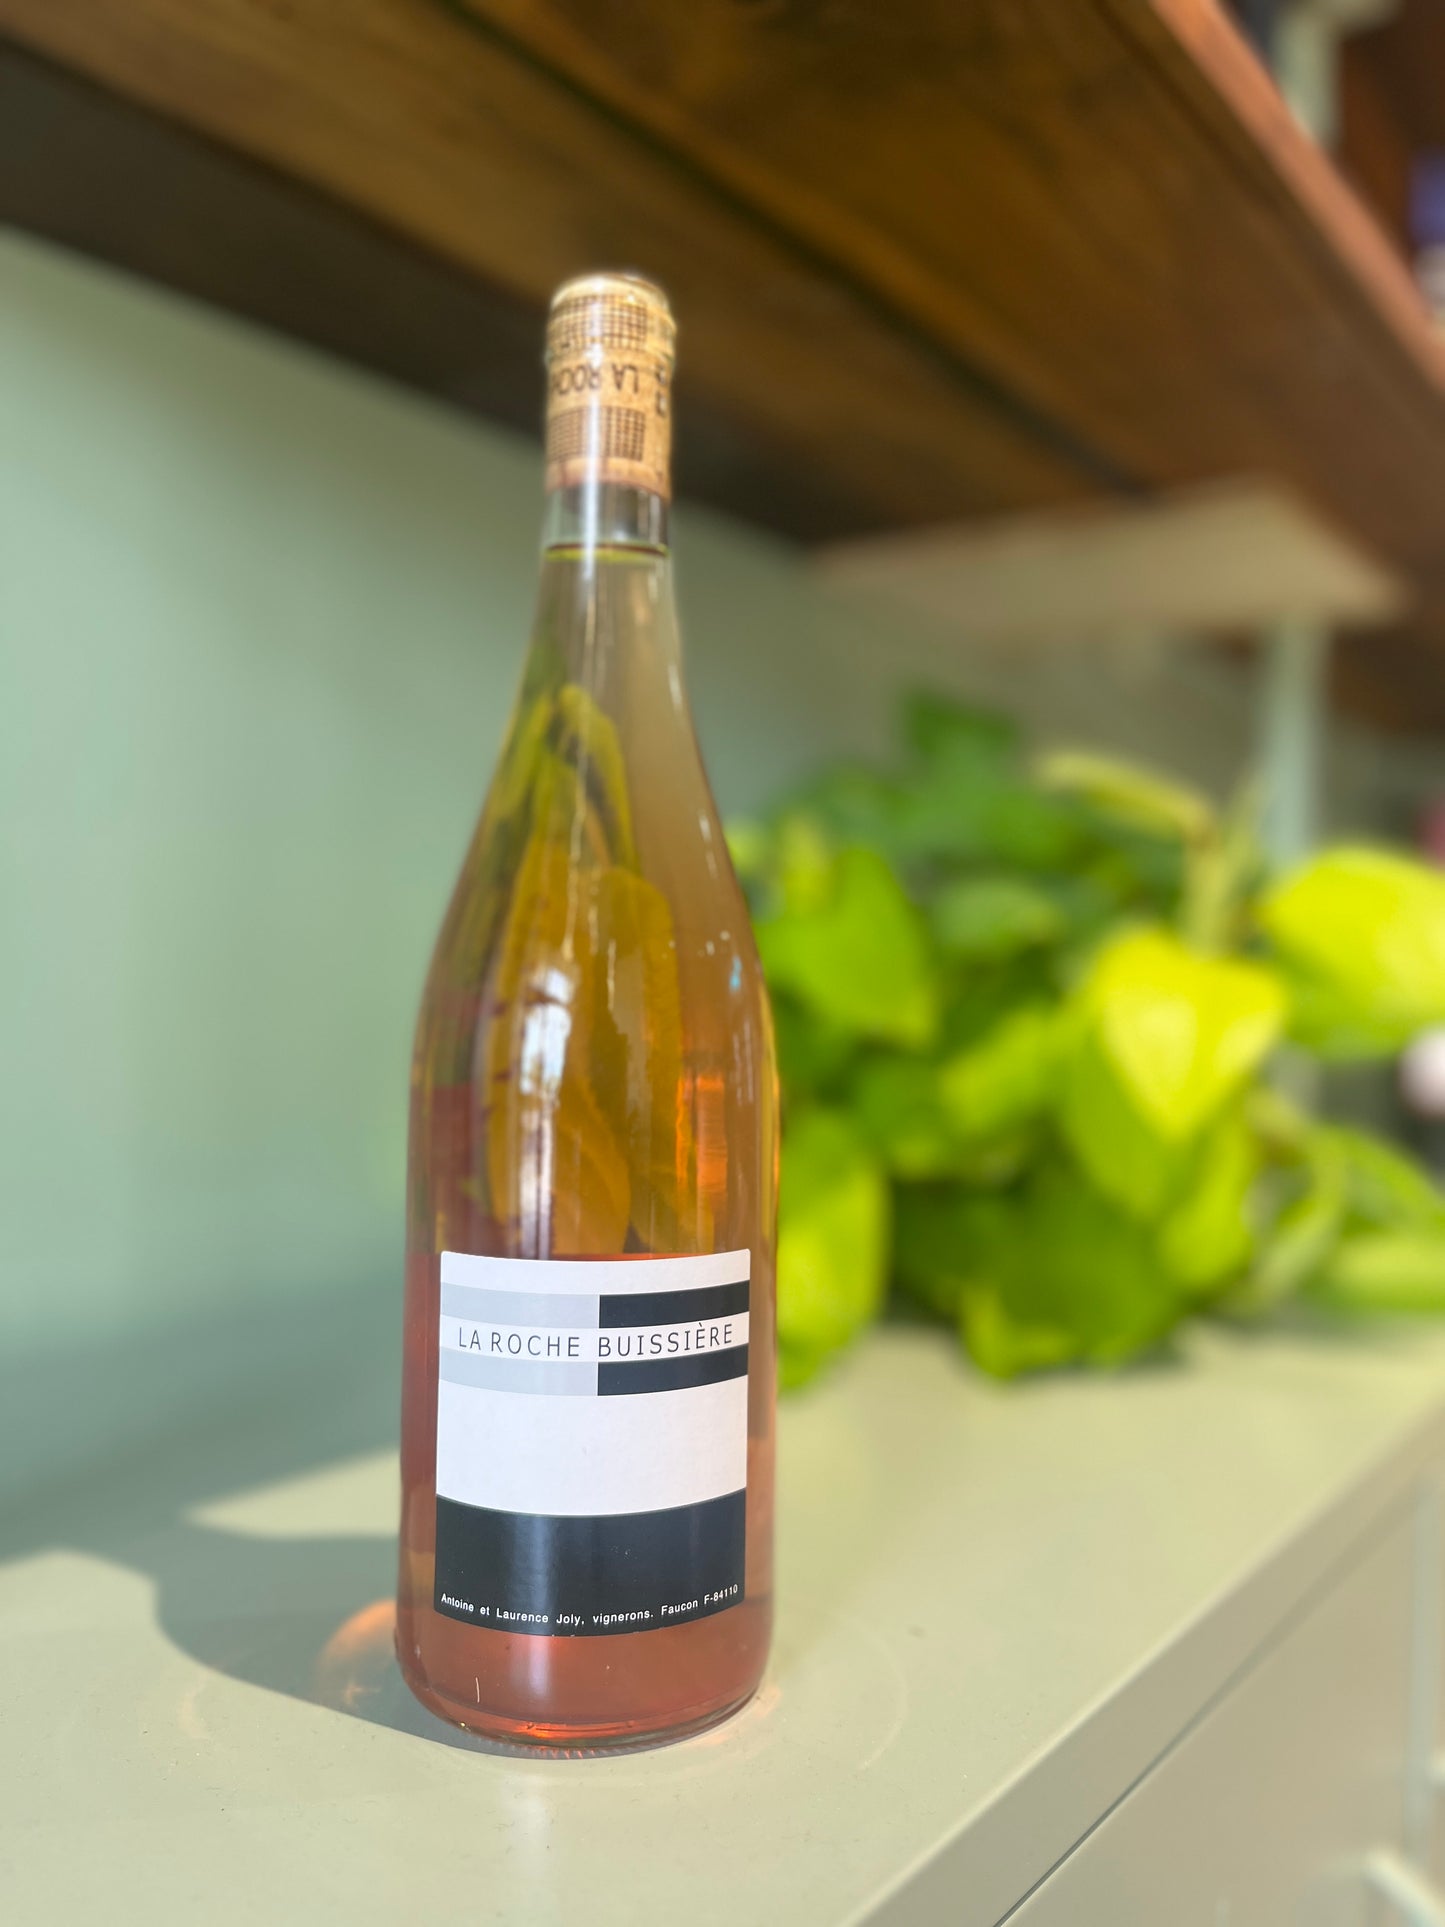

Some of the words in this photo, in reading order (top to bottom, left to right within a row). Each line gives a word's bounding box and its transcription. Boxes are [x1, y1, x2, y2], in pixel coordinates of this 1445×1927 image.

[610, 362, 640, 395] LA
[458, 1326, 482, 1351] LA
[490, 1331, 580, 1357] ROCHE
[598, 1322, 733, 1358] BUISSIÈRE
[440, 1593, 475, 1612] Antoine
[479, 1606, 490, 1616] et
[496, 1607, 549, 1623] Laurence
[556, 1613, 585, 1626] Joly,
[592, 1609, 654, 1625] vignerons.
[660, 1599, 699, 1616] Faucon
[703, 1584, 739, 1605] F-84110
